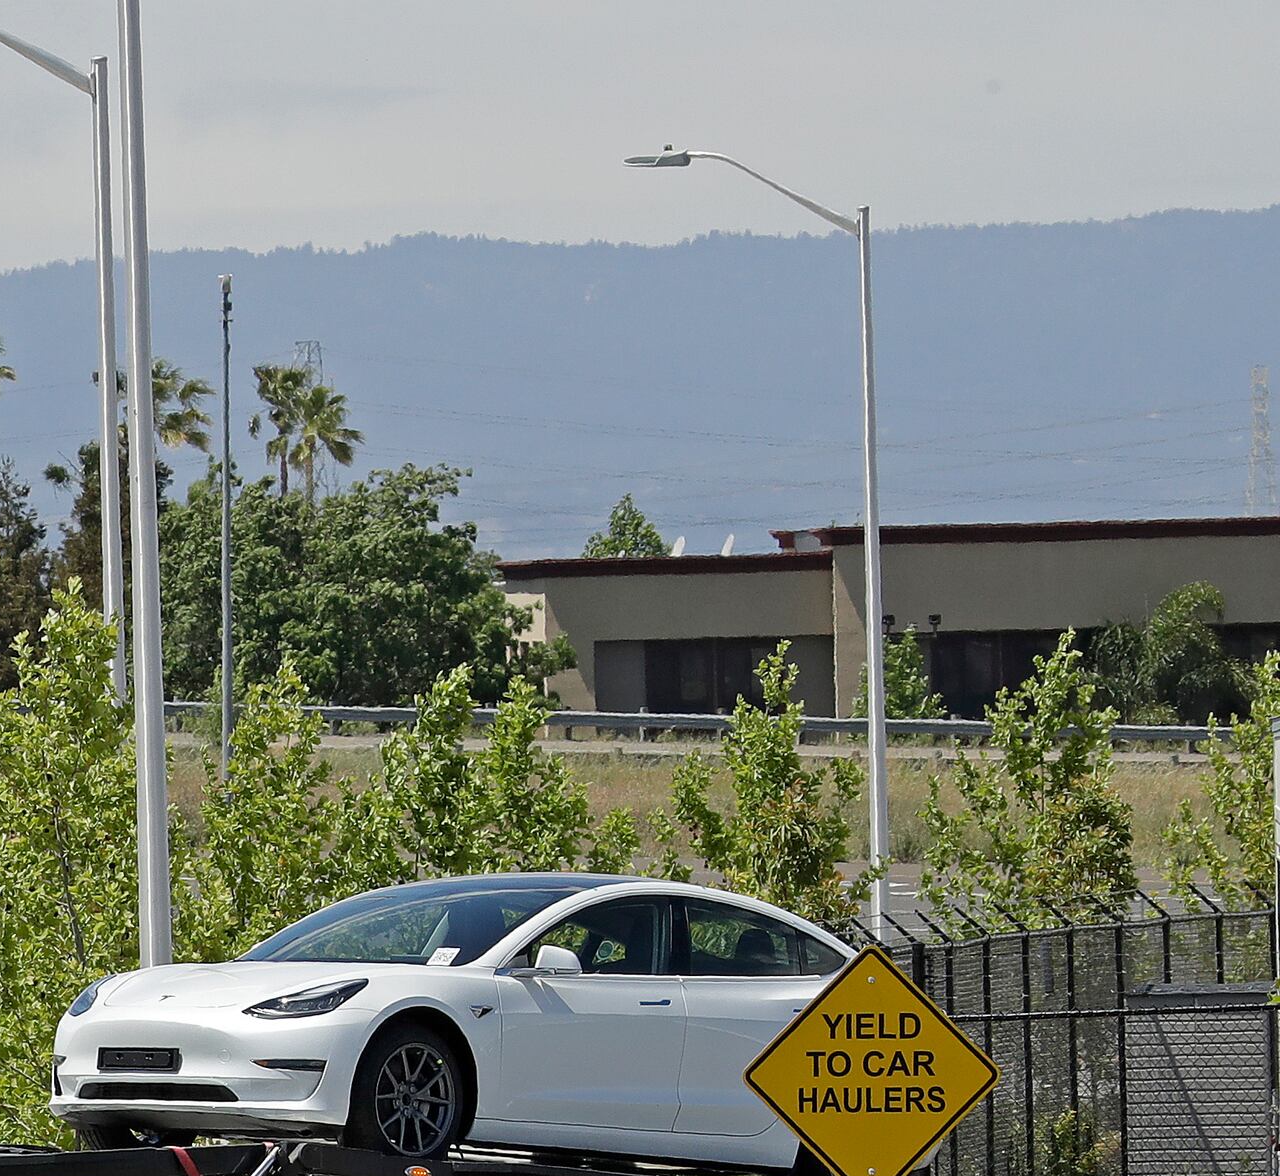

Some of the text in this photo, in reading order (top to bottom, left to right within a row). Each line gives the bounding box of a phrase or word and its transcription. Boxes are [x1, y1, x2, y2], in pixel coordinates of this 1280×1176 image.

[822, 1012, 922, 1040] YIELD
[805, 1050, 936, 1078] TO CAR
[797, 1086, 947, 1114] HAULERS
